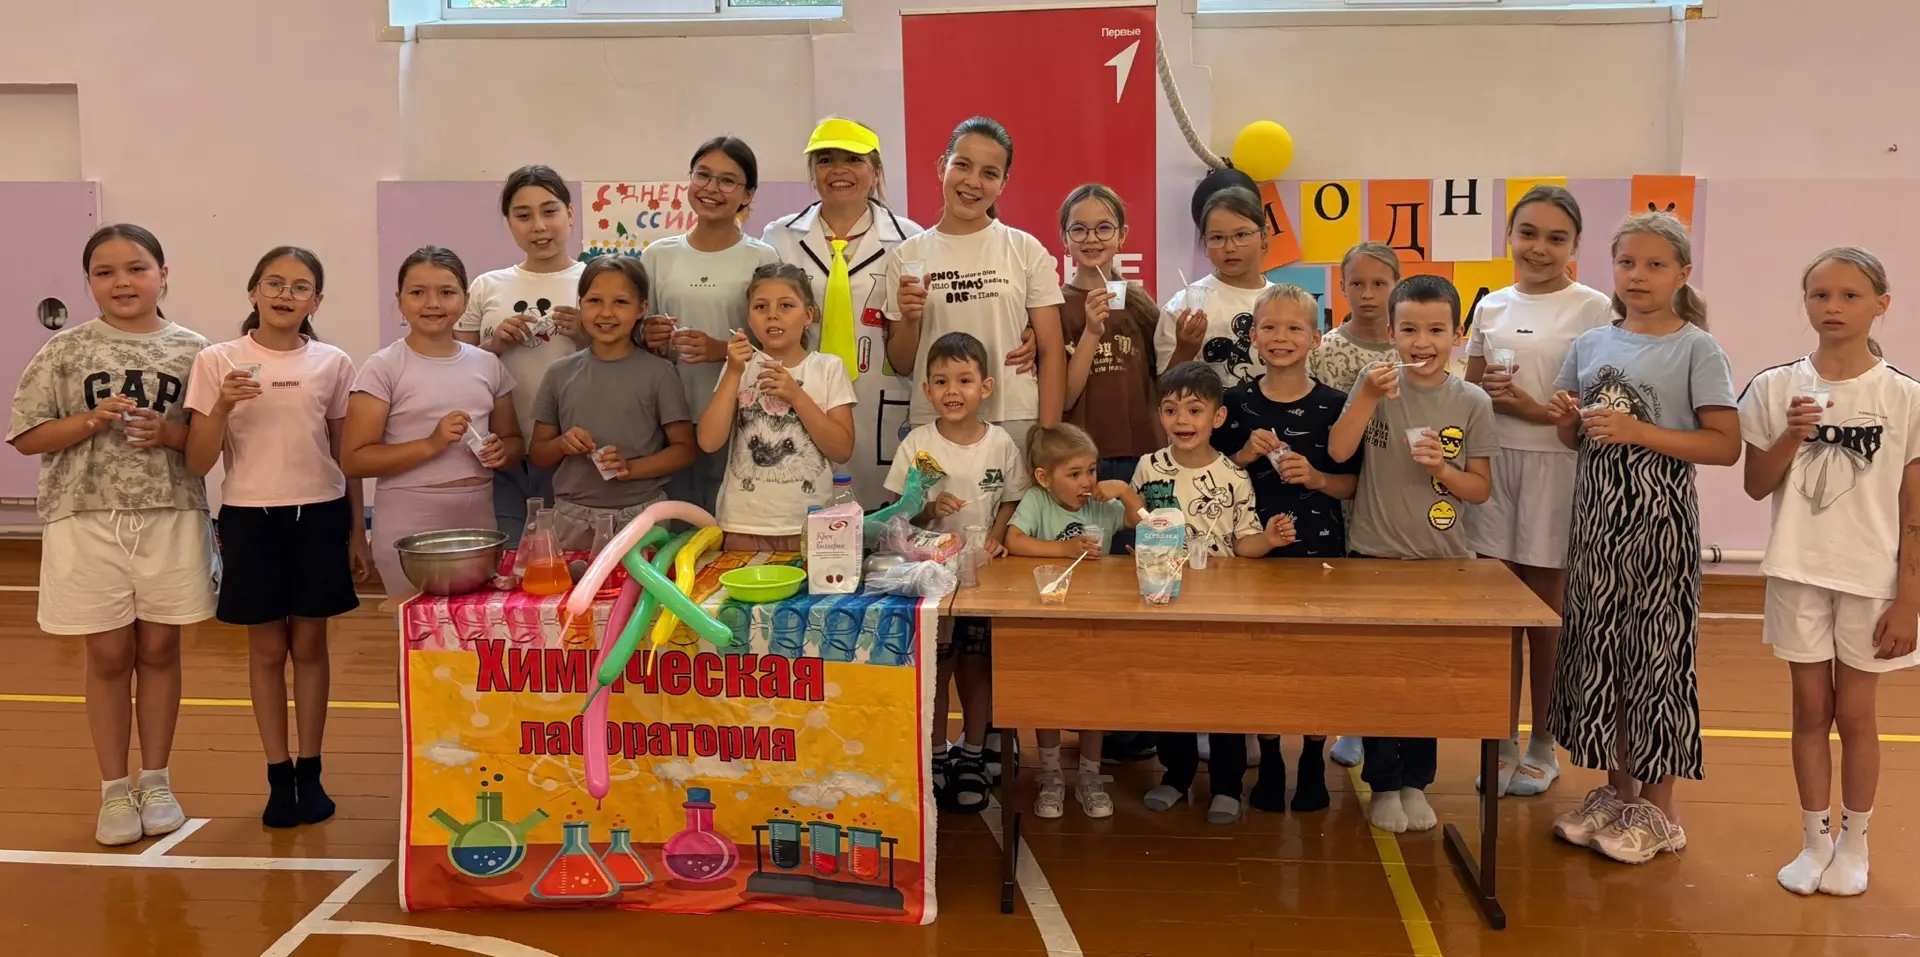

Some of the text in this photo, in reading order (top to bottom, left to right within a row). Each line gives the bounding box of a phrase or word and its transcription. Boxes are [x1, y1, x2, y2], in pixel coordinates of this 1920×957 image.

[1101, 28, 1141, 39] Первые
[84, 369, 182, 414] GAP
[475, 639, 825, 702] Химческая
